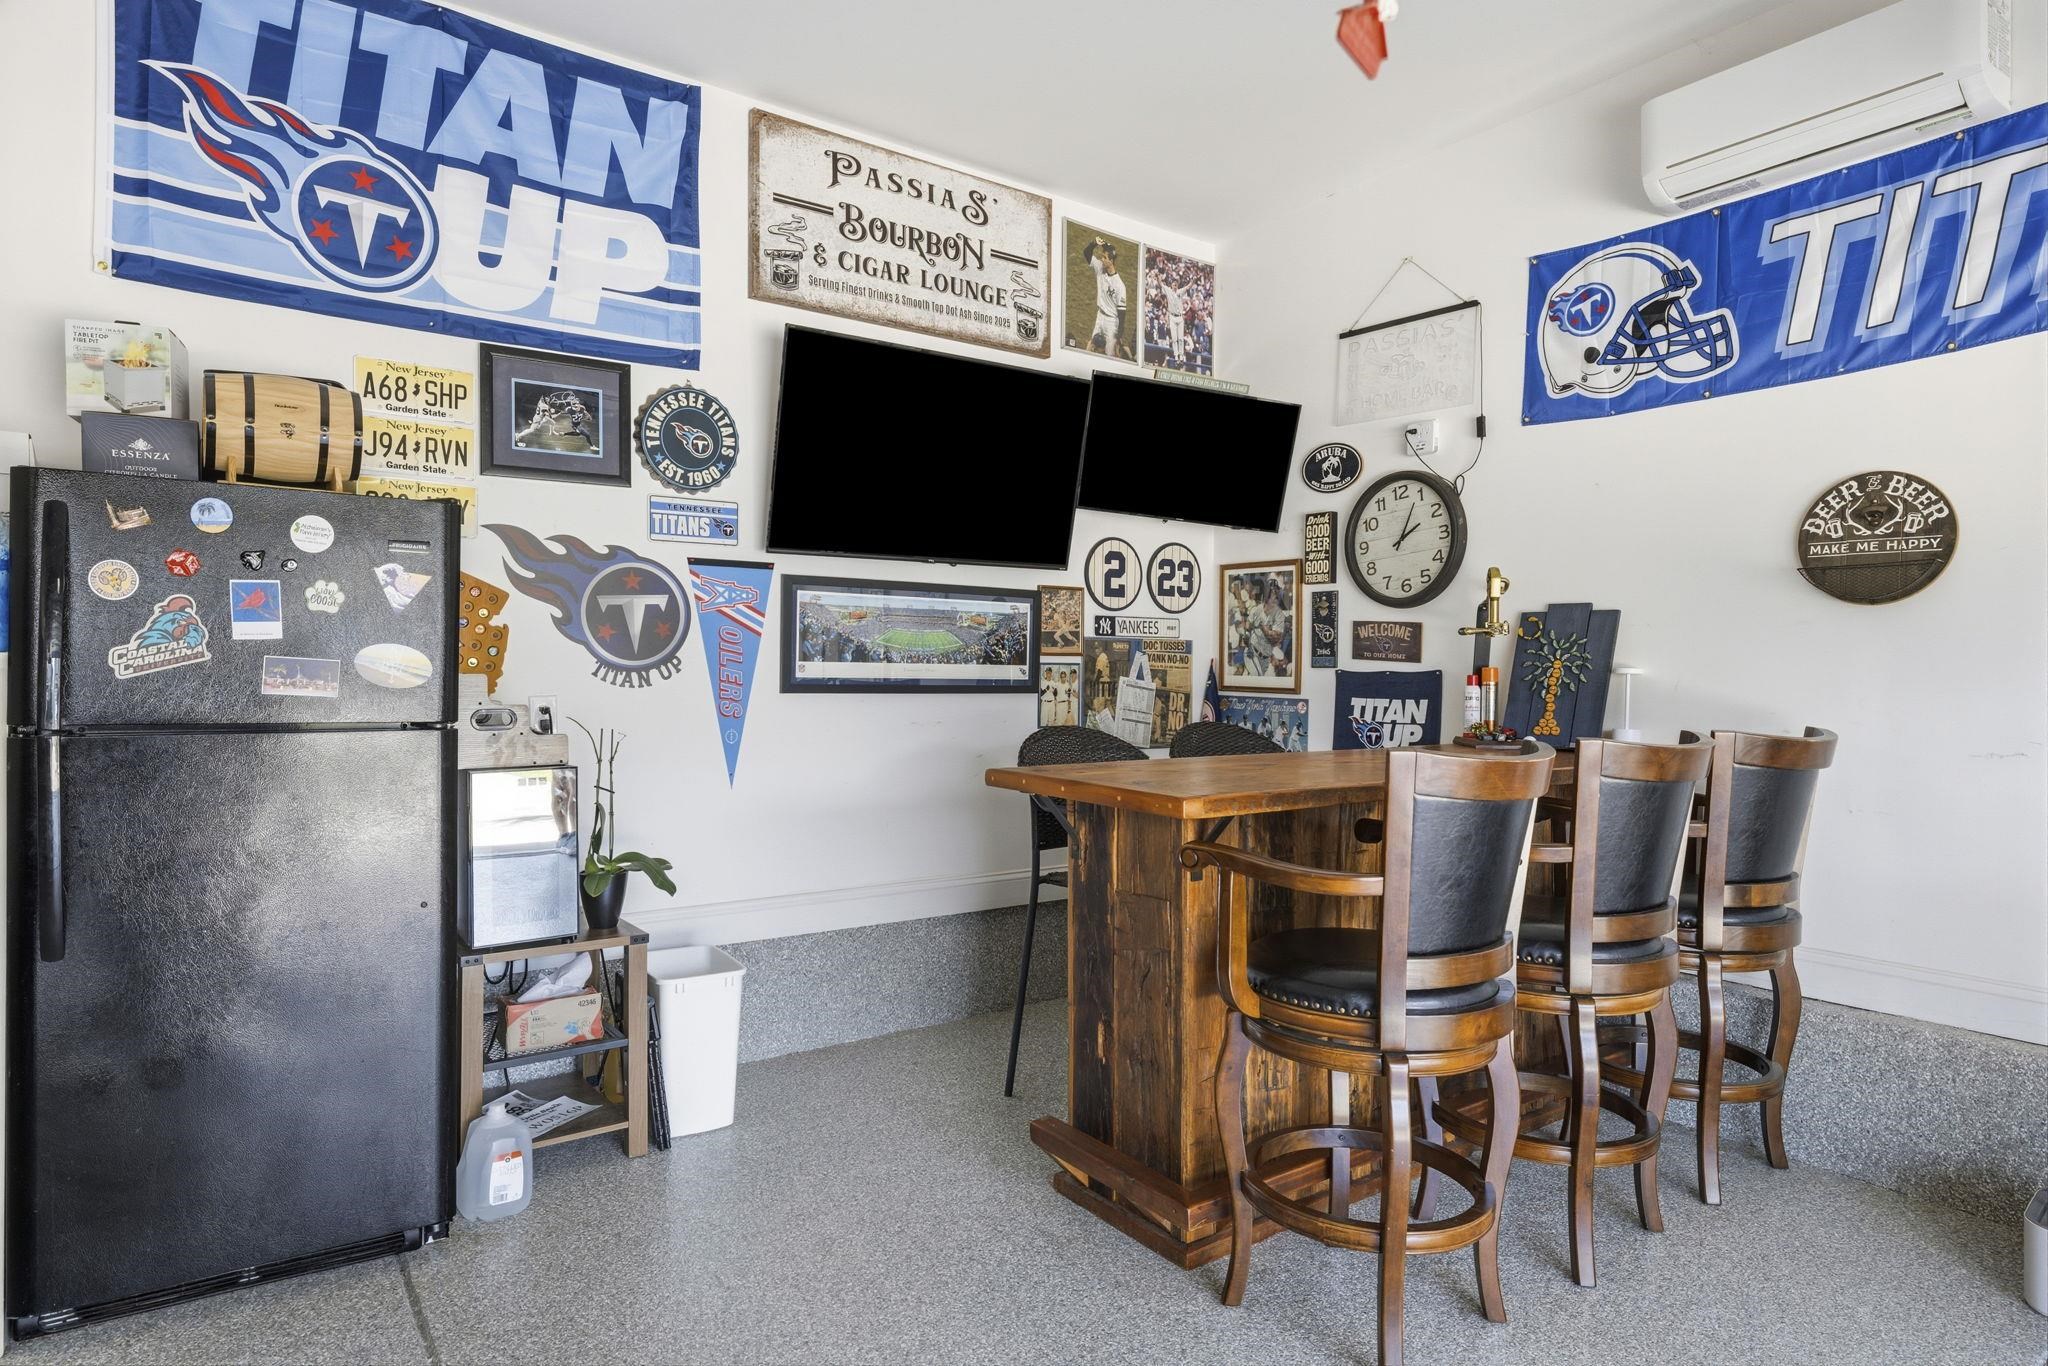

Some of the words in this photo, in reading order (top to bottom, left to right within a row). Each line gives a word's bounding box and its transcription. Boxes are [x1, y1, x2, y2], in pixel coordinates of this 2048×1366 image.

[192, 0, 689, 209] TITAN
[839, 201, 984, 270] BOURBON
[428, 164, 669, 324] UP
[1766, 142, 2048, 350] TIT
[813, 242, 827, 267] &
[838, 251, 911, 285] CIGAR
[920, 269, 1008, 307] LOUNGE
[808, 274, 840, 292] Serving
[841, 282, 866, 297] Finest
[868, 287, 893, 302] Drinks
[901, 294, 930, 311] Smooth
[973, 310, 993, 325] Since
[994, 315, 1011, 328] 2025
[73, 331, 109, 339] TABLETOP
[384, 361, 411, 376] New
[412, 365, 446, 380] Jersey
[363, 372, 406, 400] A68
[424, 380, 467, 410] SHP
[385, 402, 420, 416] Garden
[422, 407, 447, 418] State
[386, 419, 412, 433] New
[413, 422, 447, 437] Jersey
[645, 392, 705, 448] TENNESSEE
[708, 397, 734, 459] TITANS
[112, 449, 169, 460] ESSENZA
[363, 430, 406, 459] J94
[425, 438, 468, 467] RVN
[1315, 447, 1347, 462] ARUBA
[386, 460, 420, 474] Garden
[422, 465, 447, 476] State
[661, 460, 685, 484] EST.
[687, 467, 721, 486] 1960
[388, 480, 414, 491] New
[416, 482, 449, 496] Jersey
[1392, 484, 1409, 500] 12
[1417, 487, 1424, 501] 1
[667, 503, 722, 514] TENNESSEE
[1375, 497, 1386, 511] 11
[1430, 502, 1442, 518] 2
[1803, 480, 1865, 535] DEER
[1884, 475, 1950, 525] BEER
[652, 513, 711, 537] TITANS
[1307, 513, 1329, 525] Drink
[1362, 517, 1379, 532] 10
[1306, 524, 1330, 538] GOOD
[1439, 524, 1450, 540] 3
[1306, 537, 1329, 551] BEER
[1359, 541, 1369, 555] 9
[1810, 543, 1849, 555] MAKE
[1856, 541, 1879, 551] ME
[1886, 538, 1941, 550] HAPPY
[1432, 549, 1444, 563] 4
[1104, 551, 1126, 597] 2
[1306, 560, 1329, 574] GOOD
[1366, 561, 1377, 576] 8
[1158, 558, 1194, 598] 23
[1305, 573, 1329, 583] FRIENDS
[1382, 576, 1392, 590] 7
[1420, 569, 1431, 584] 5
[1401, 579, 1412, 593] 6
[1117, 619, 1159, 635] YANKEES
[1358, 623, 1413, 640] WELCOME
[114, 640, 188, 664] COASTAL
[1143, 640, 1159, 650] DOC
[1160, 641, 1185, 651] TOSSES
[120, 645, 203, 675] CAROLINA
[1147, 653, 1167, 663] YANK
[1167, 655, 1189, 665] NO-NO
[591, 661, 653, 689] TITAN
[658, 655, 683, 680] UP
[718, 625, 744, 719] OILERS
[1169, 691, 1188, 712] DR.
[1351, 697, 1428, 724] TITAN
[1168, 711, 1184, 730] NO
[1383, 723, 1423, 748] UP
